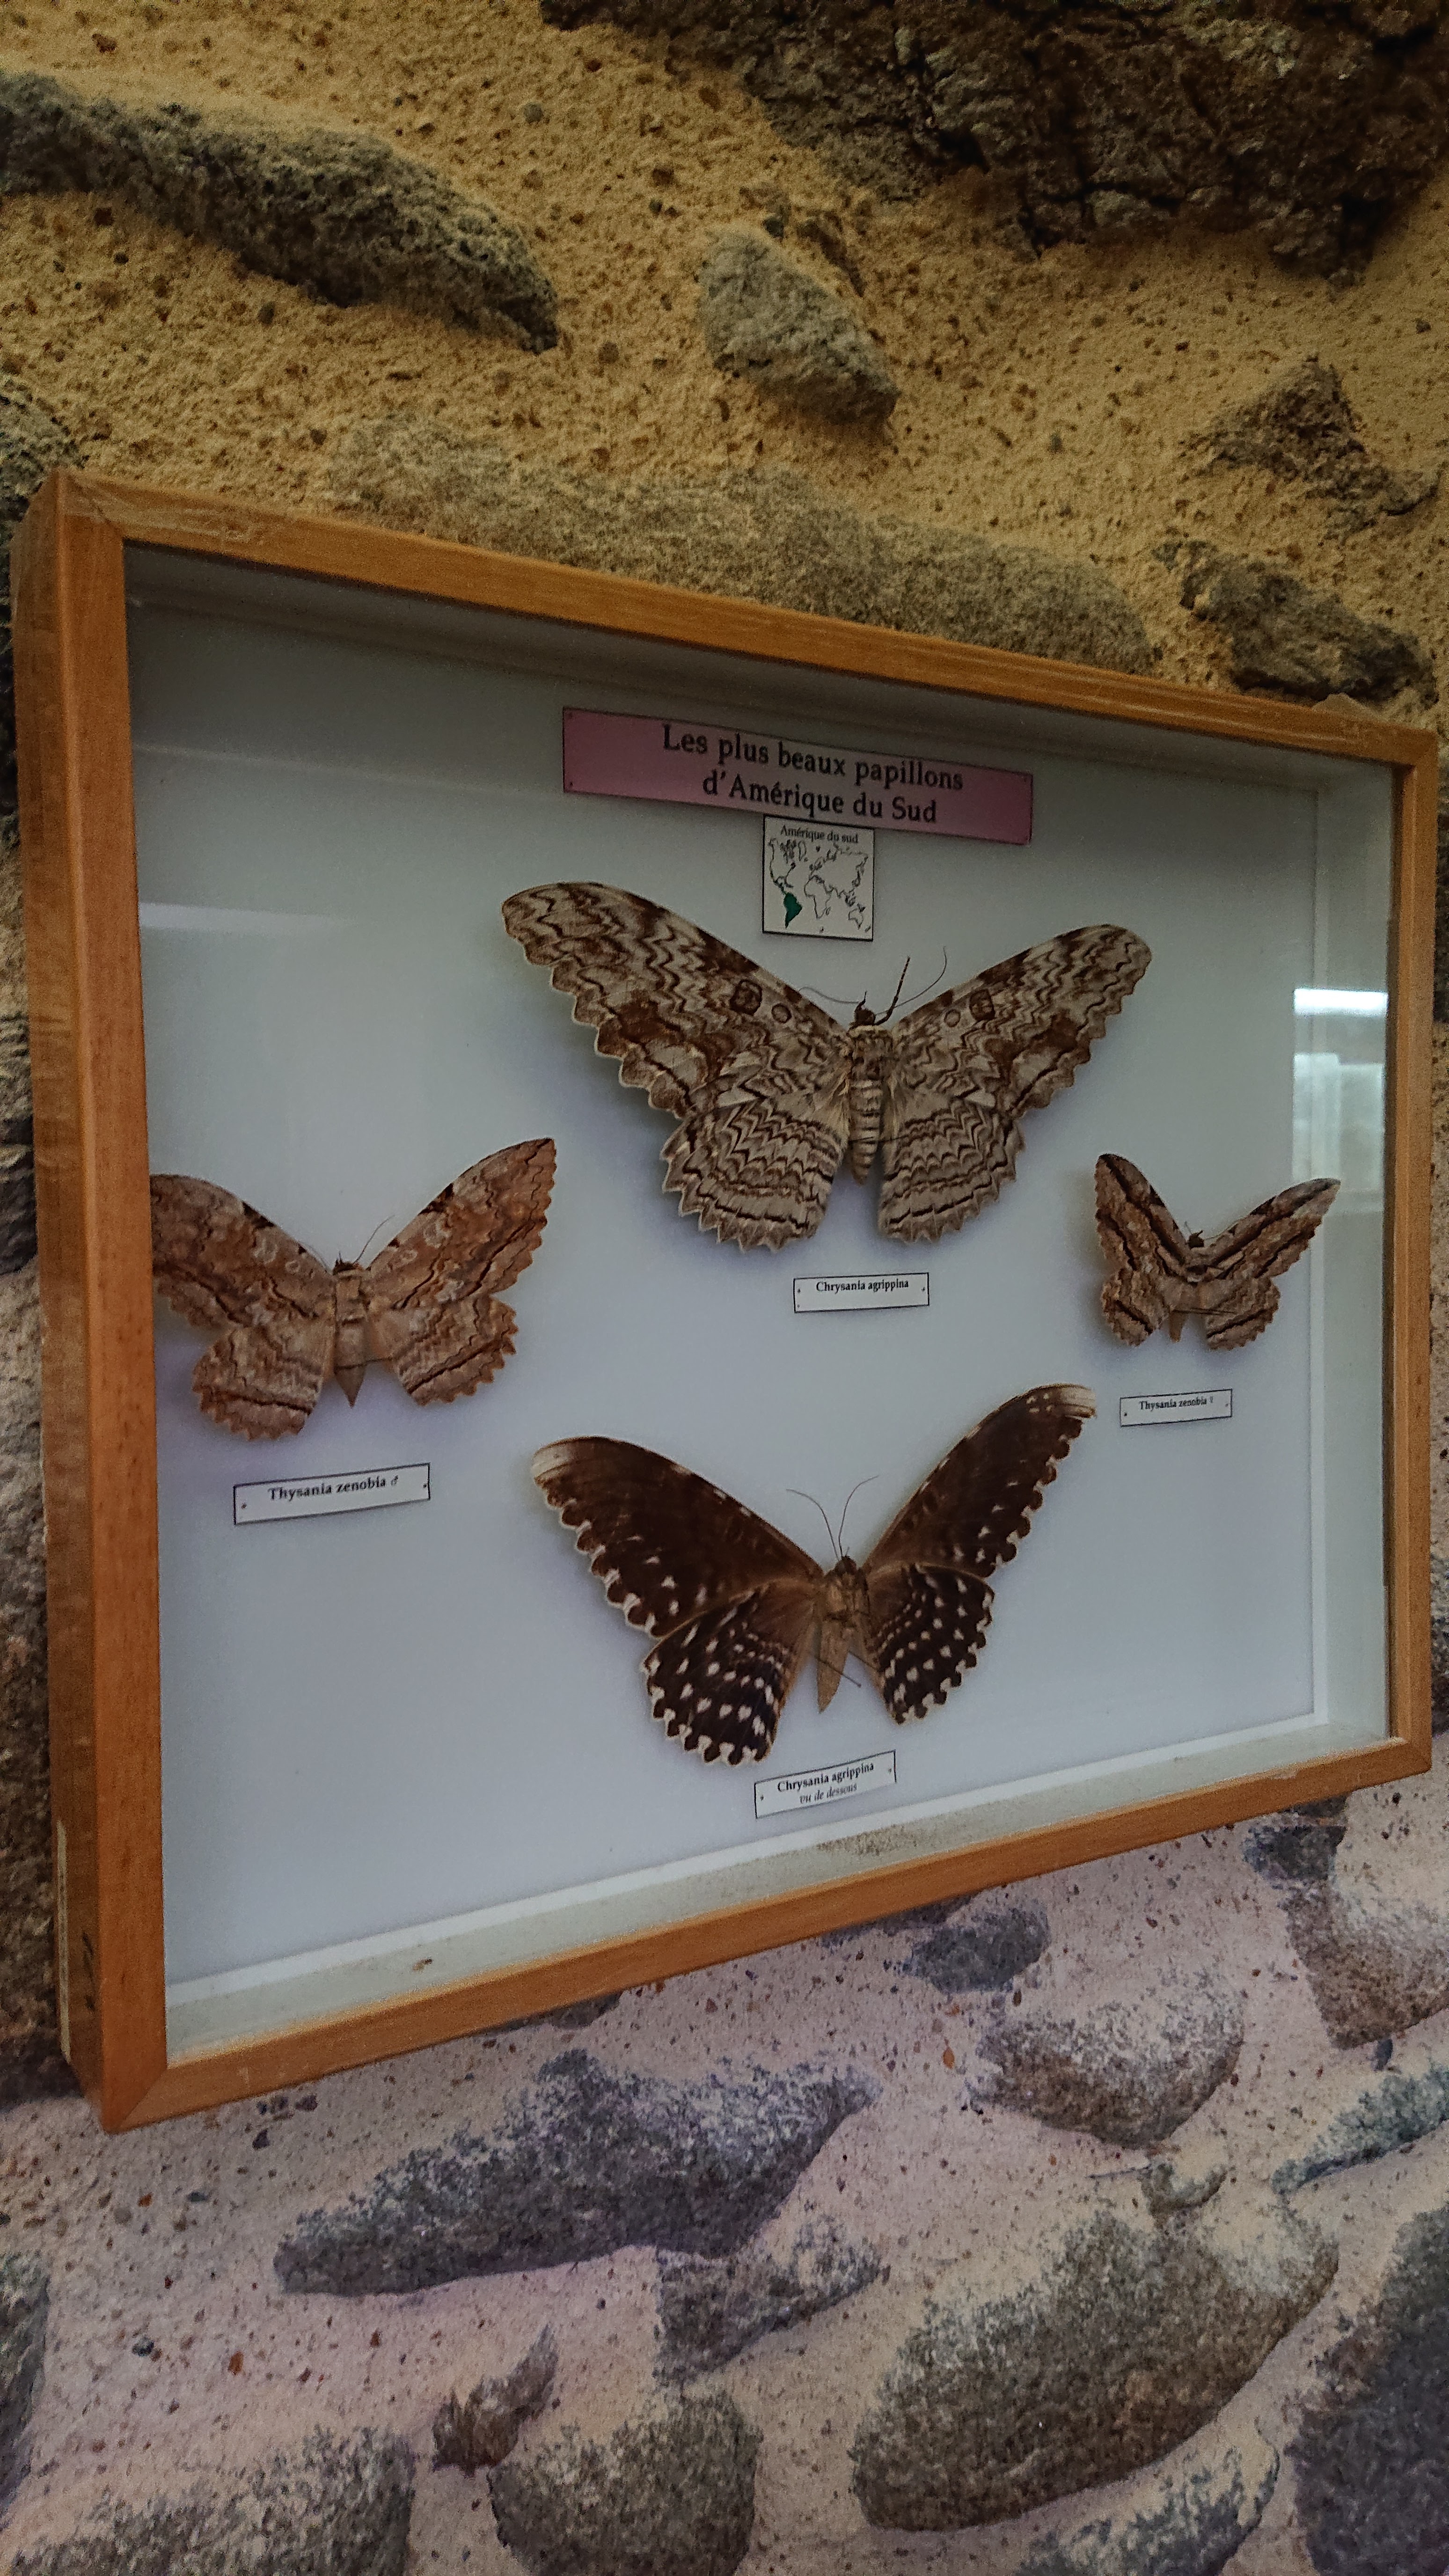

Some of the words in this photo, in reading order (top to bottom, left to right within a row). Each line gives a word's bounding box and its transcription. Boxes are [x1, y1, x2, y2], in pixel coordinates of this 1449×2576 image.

[663, 724, 708, 754] Les
[717, 733, 769, 765] plus
[778, 740, 846, 776] beaux
[855, 760, 963, 790] papillons
[703, 768, 844, 818] d'Amérique
[853, 792, 882, 818] du
[892, 796, 936, 823] Sud
[780, 825, 825, 842] Amérique
[827, 830, 839, 842] du
[842, 834, 858, 843] sud
[816, 1280, 865, 1294] Chrysania
[868, 1278, 909, 1292] agrippina
[268, 1483, 331, 1501] Thysania
[336, 1476, 385, 1493] zenobia
[777, 1773, 829, 1792] Chrysania
[832, 1762, 874, 1783] agrippina
